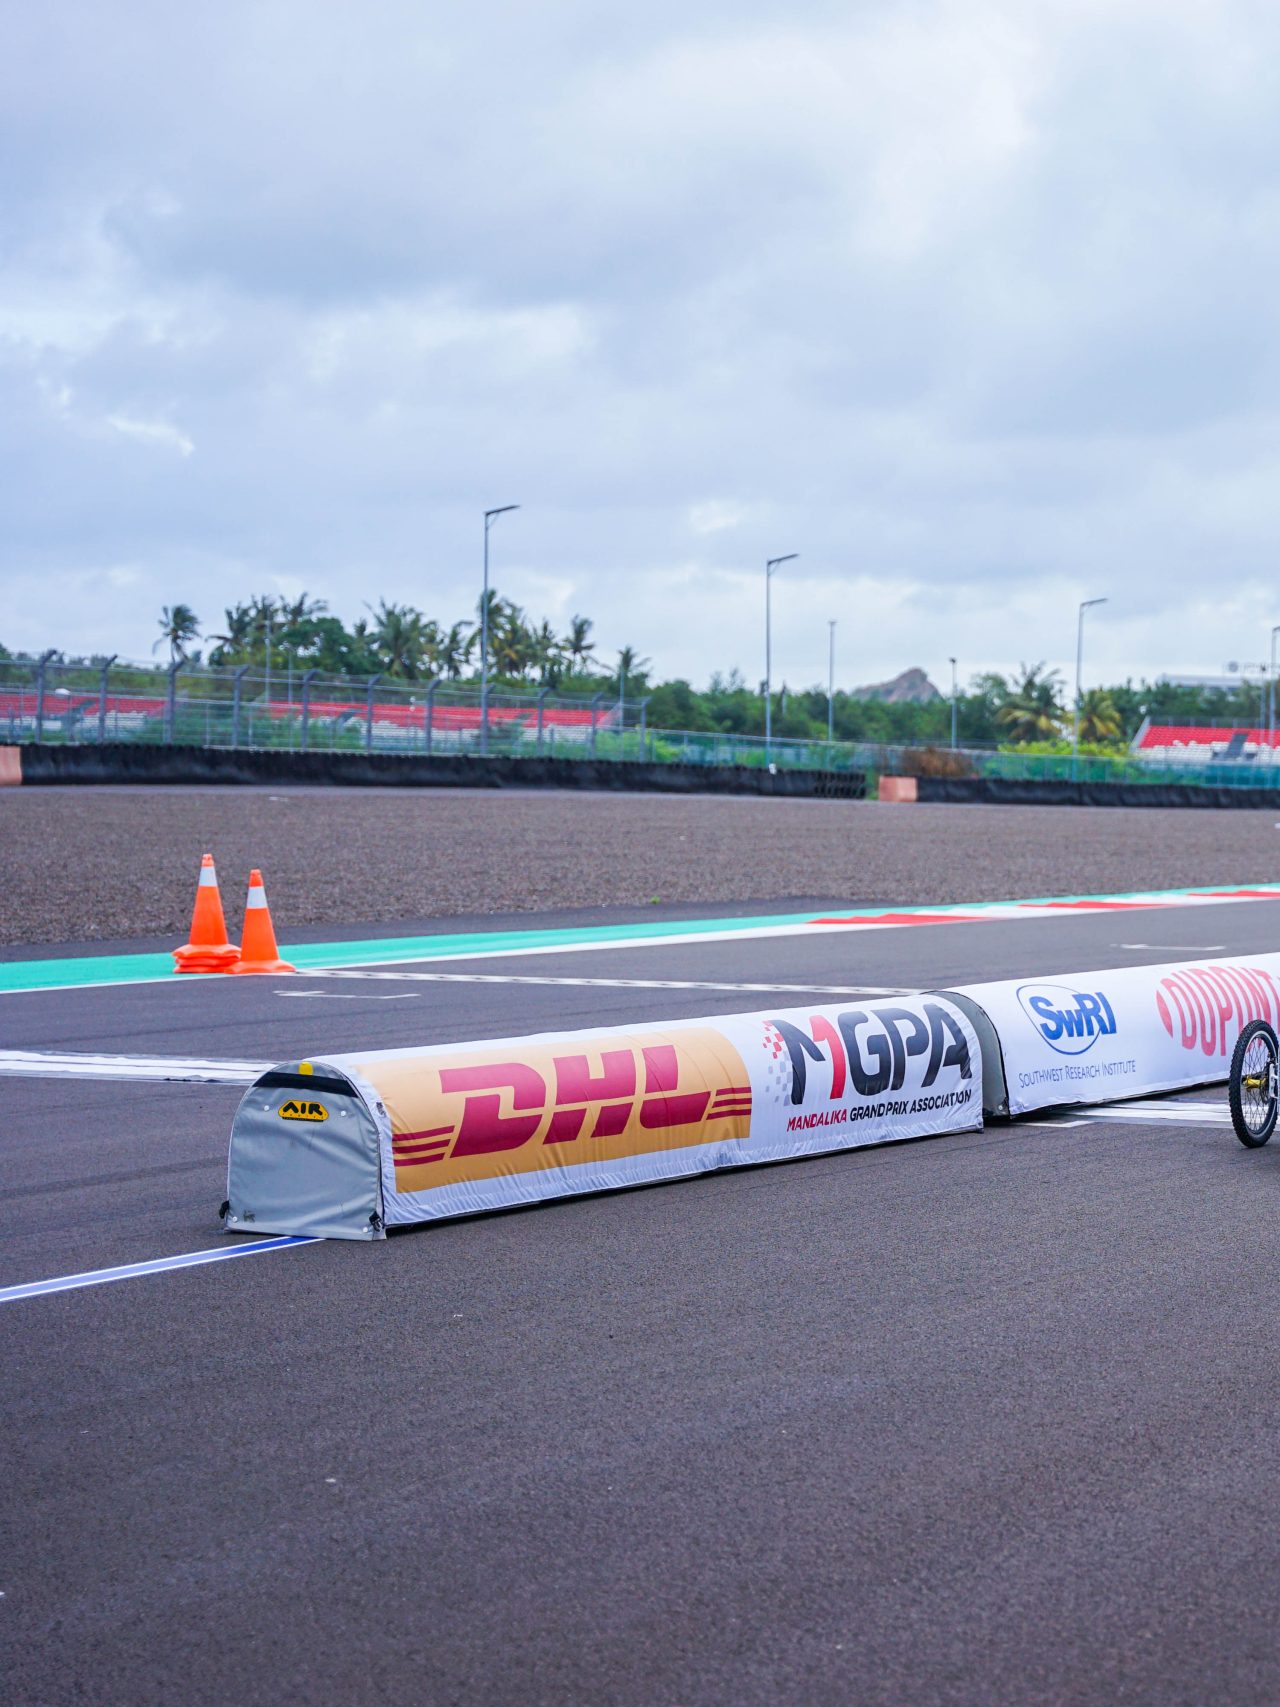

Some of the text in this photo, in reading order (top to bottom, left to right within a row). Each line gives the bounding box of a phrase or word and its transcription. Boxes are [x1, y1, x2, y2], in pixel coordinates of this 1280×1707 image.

[1029, 992, 1117, 1040] SwRI
[769, 1003, 973, 1105] MGPA
[1019, 1060, 1136, 1088] SOUTHWEST RESEARCH INSTITUTE
[283, 1102, 323, 1116] AIR
[439, 1045, 712, 1158] DHL
[787, 1089, 973, 1132] MANDALIKA GRAND PRIX ASSOCIATION
